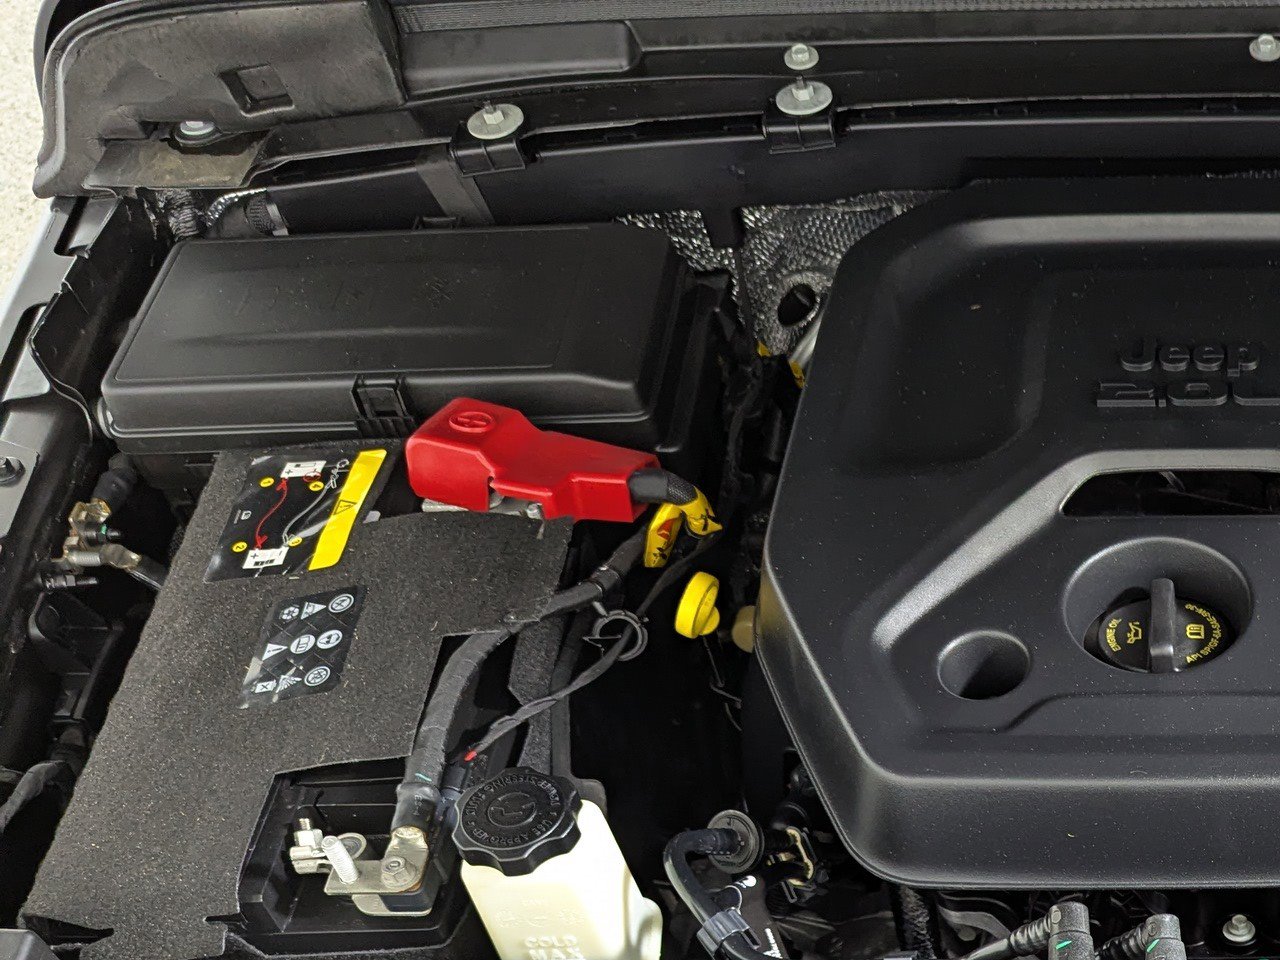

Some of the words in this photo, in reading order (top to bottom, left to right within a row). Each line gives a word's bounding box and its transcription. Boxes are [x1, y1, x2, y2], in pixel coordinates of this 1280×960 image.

[1121, 338, 1259, 377] Jeep
[1106, 628, 1121, 652] ENGINE
[1185, 653, 1203, 663] API
[525, 934, 578, 948] COLD
[528, 947, 584, 960] MAX
